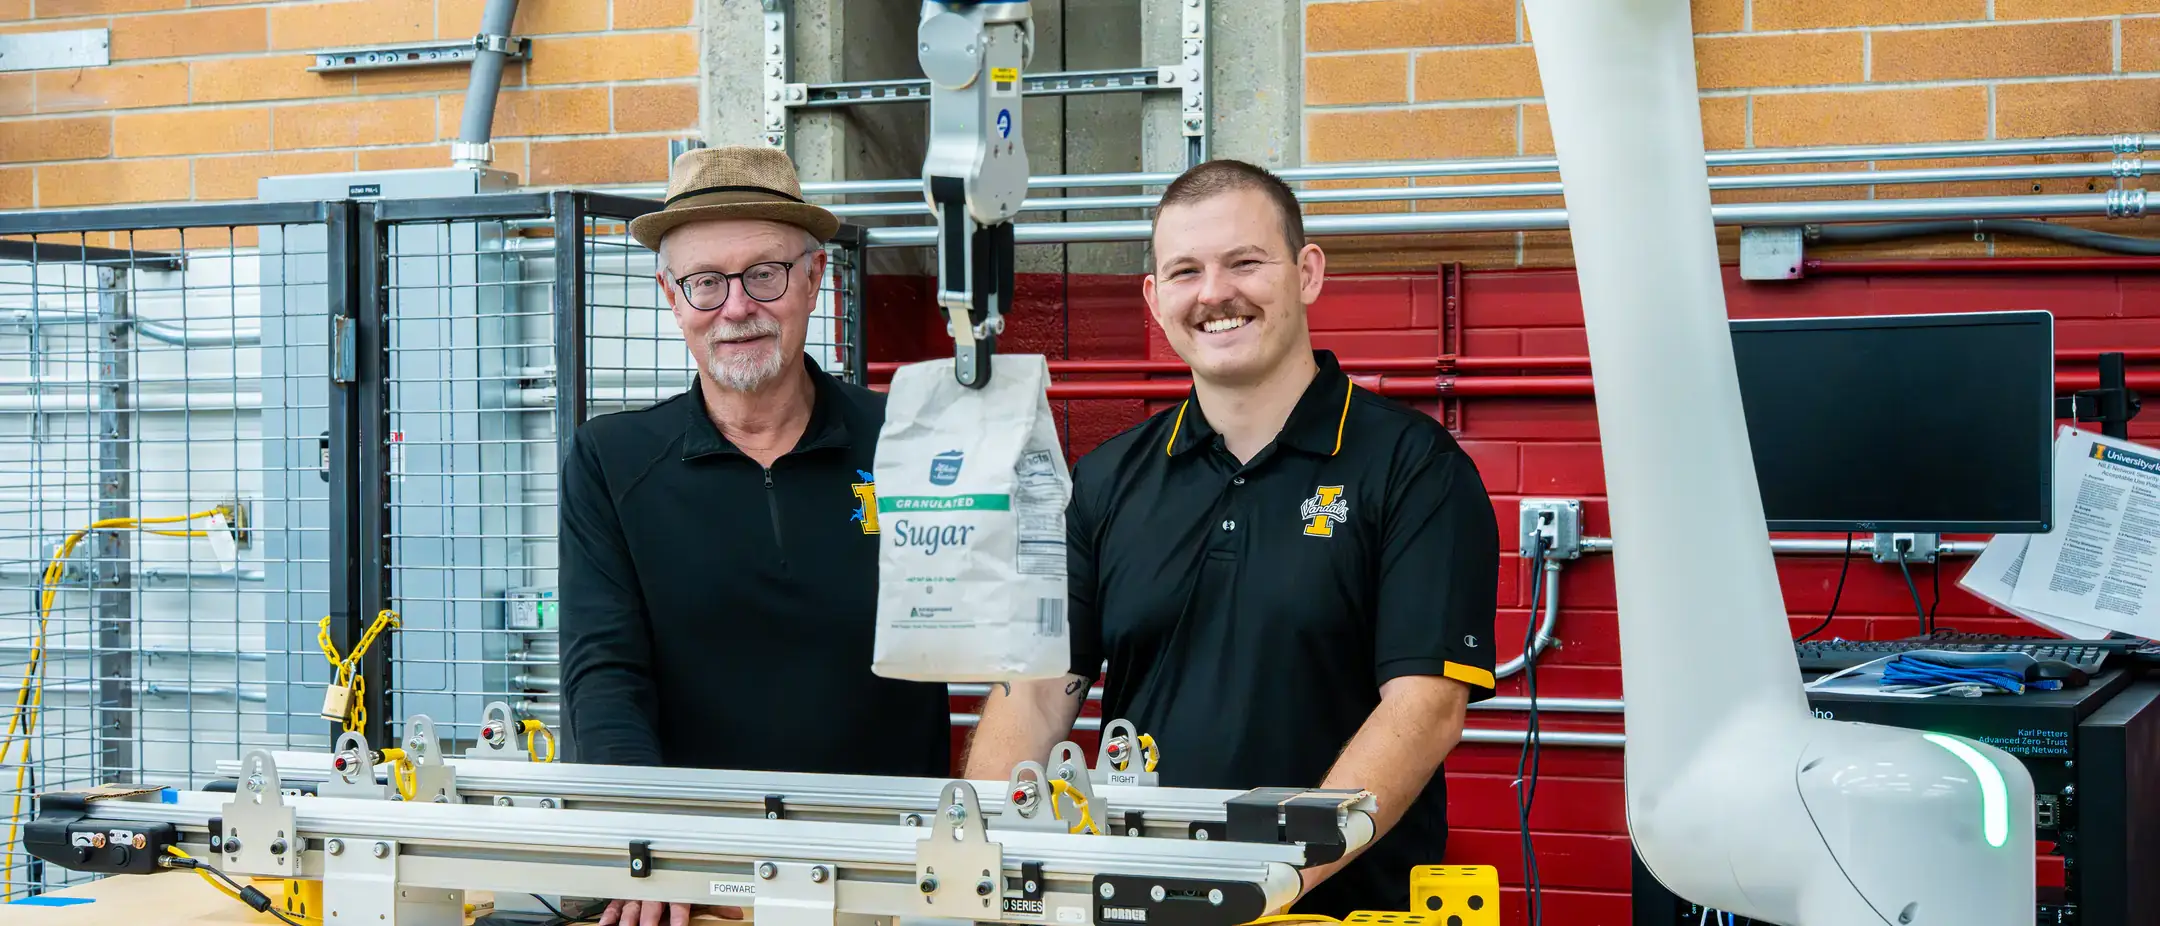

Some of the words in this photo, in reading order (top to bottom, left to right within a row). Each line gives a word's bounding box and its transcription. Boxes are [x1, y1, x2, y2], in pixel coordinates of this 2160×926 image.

[2107, 450, 2149, 470] University
[895, 497, 974, 509] GRANULATED
[1300, 495, 1349, 523] Vandals
[893, 519, 975, 556] Sugar
[2018, 728, 2035, 737] Karl
[2036, 729, 2069, 738] Petters
[1979, 736, 2020, 745] Advanced
[2021, 737, 2068, 747] Zero-Trust
[2031, 746, 2069, 755] Network
[1111, 774, 1136, 784] RIGHT
[714, 884, 756, 894] FORWARD
[1010, 899, 1043, 913] SERIES
